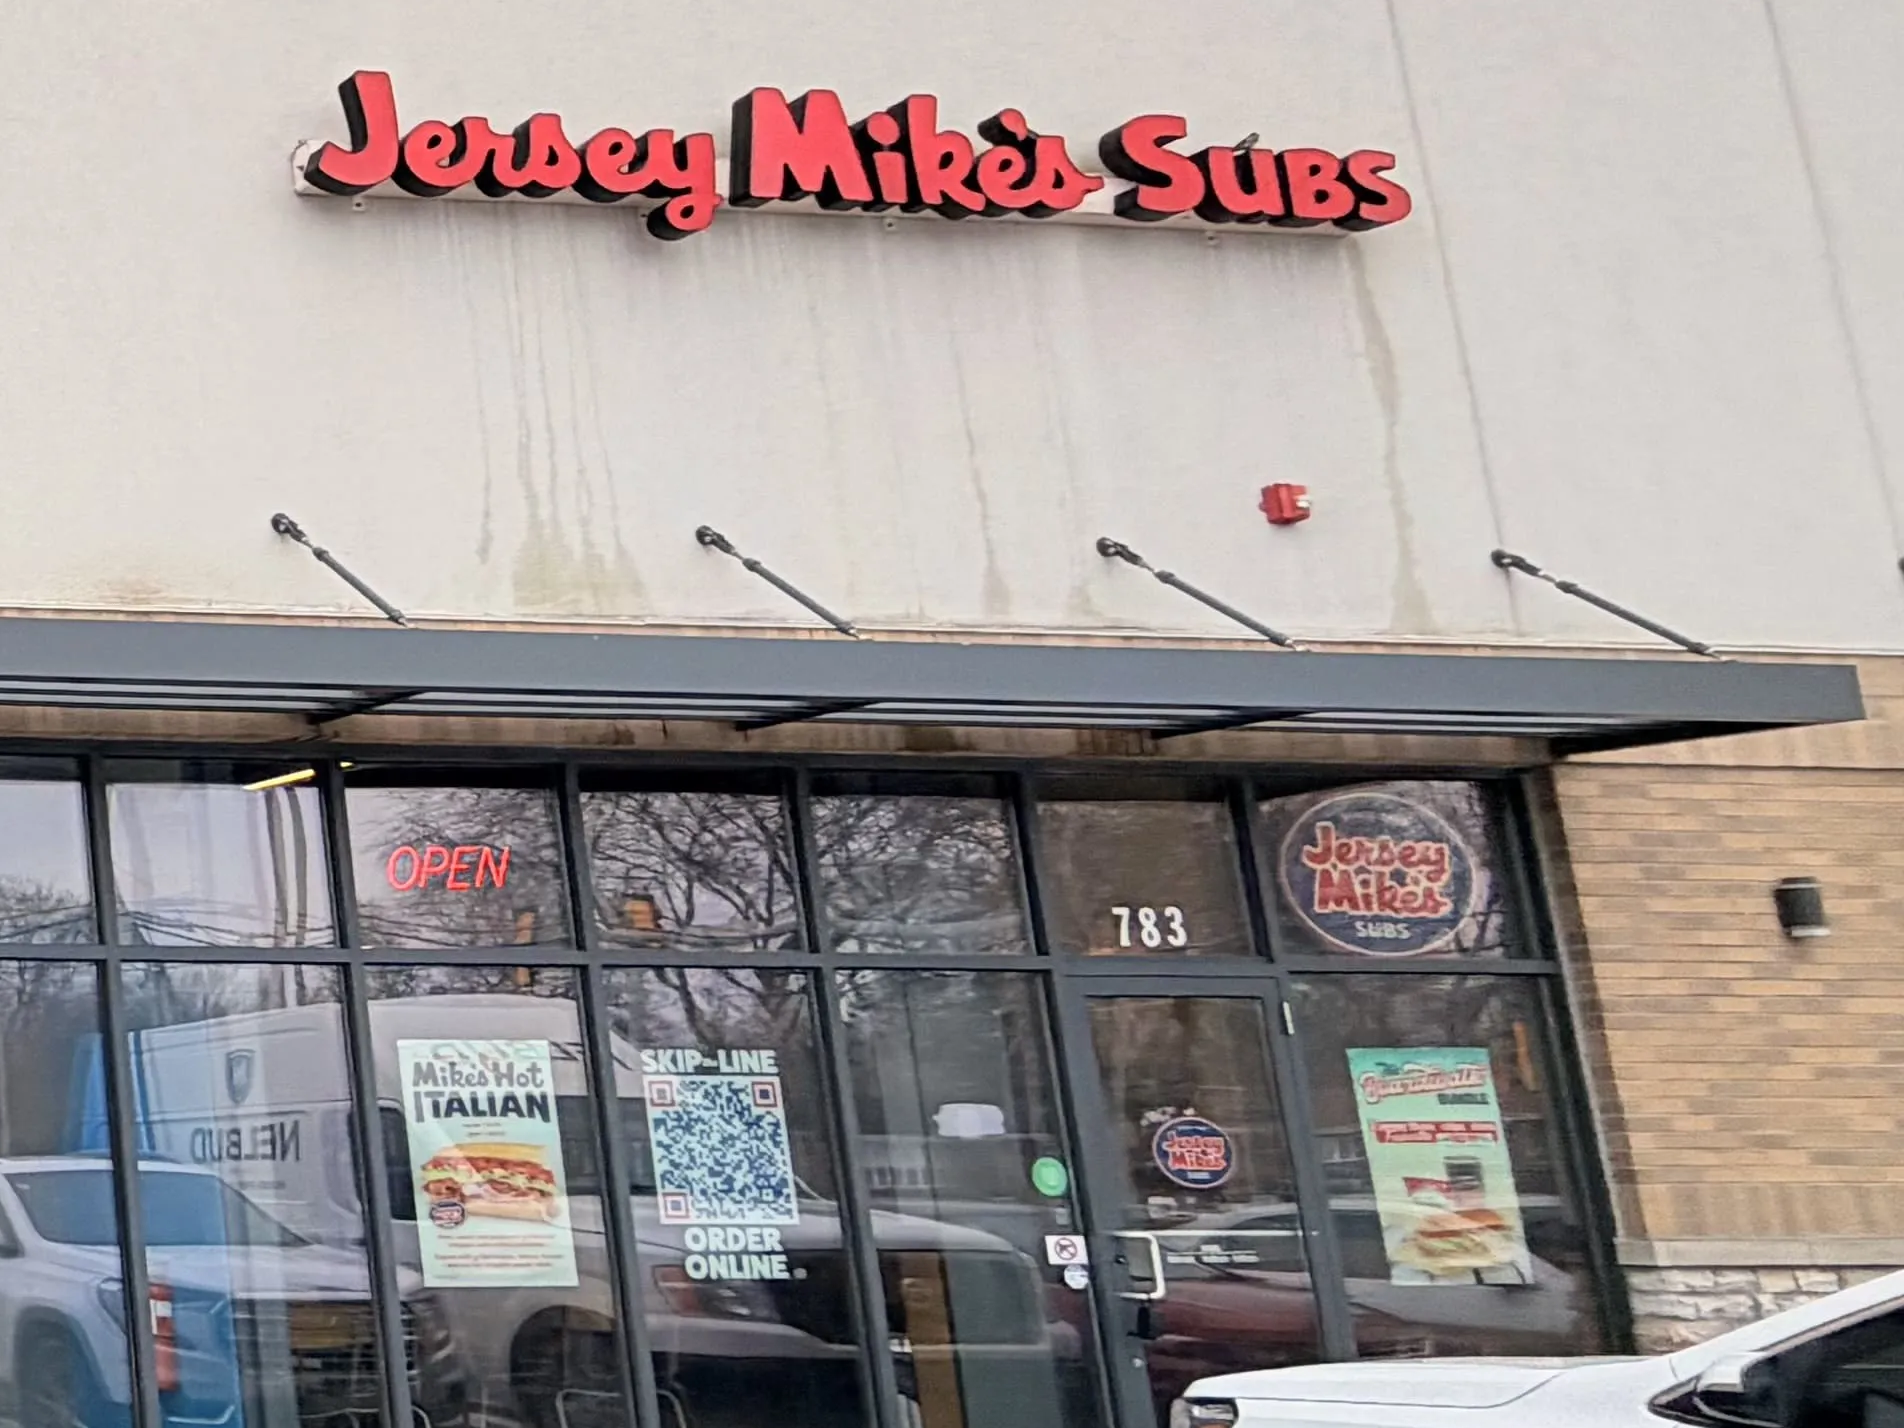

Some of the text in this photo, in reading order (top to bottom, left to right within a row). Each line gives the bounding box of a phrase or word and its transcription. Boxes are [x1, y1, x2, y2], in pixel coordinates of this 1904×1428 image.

[300, 69, 722, 239] Jersey
[730, 85, 1104, 214] Mike's
[386, 845, 511, 891] OPEN
[1302, 821, 1453, 887] Jersey
[1111, 906, 1188, 948] 783
[491, 1061, 544, 1088] Hot
[414, 1090, 552, 1123] ITALIAN
[684, 1227, 784, 1252] ORDER
[684, 1254, 791, 1280] ONLINE
